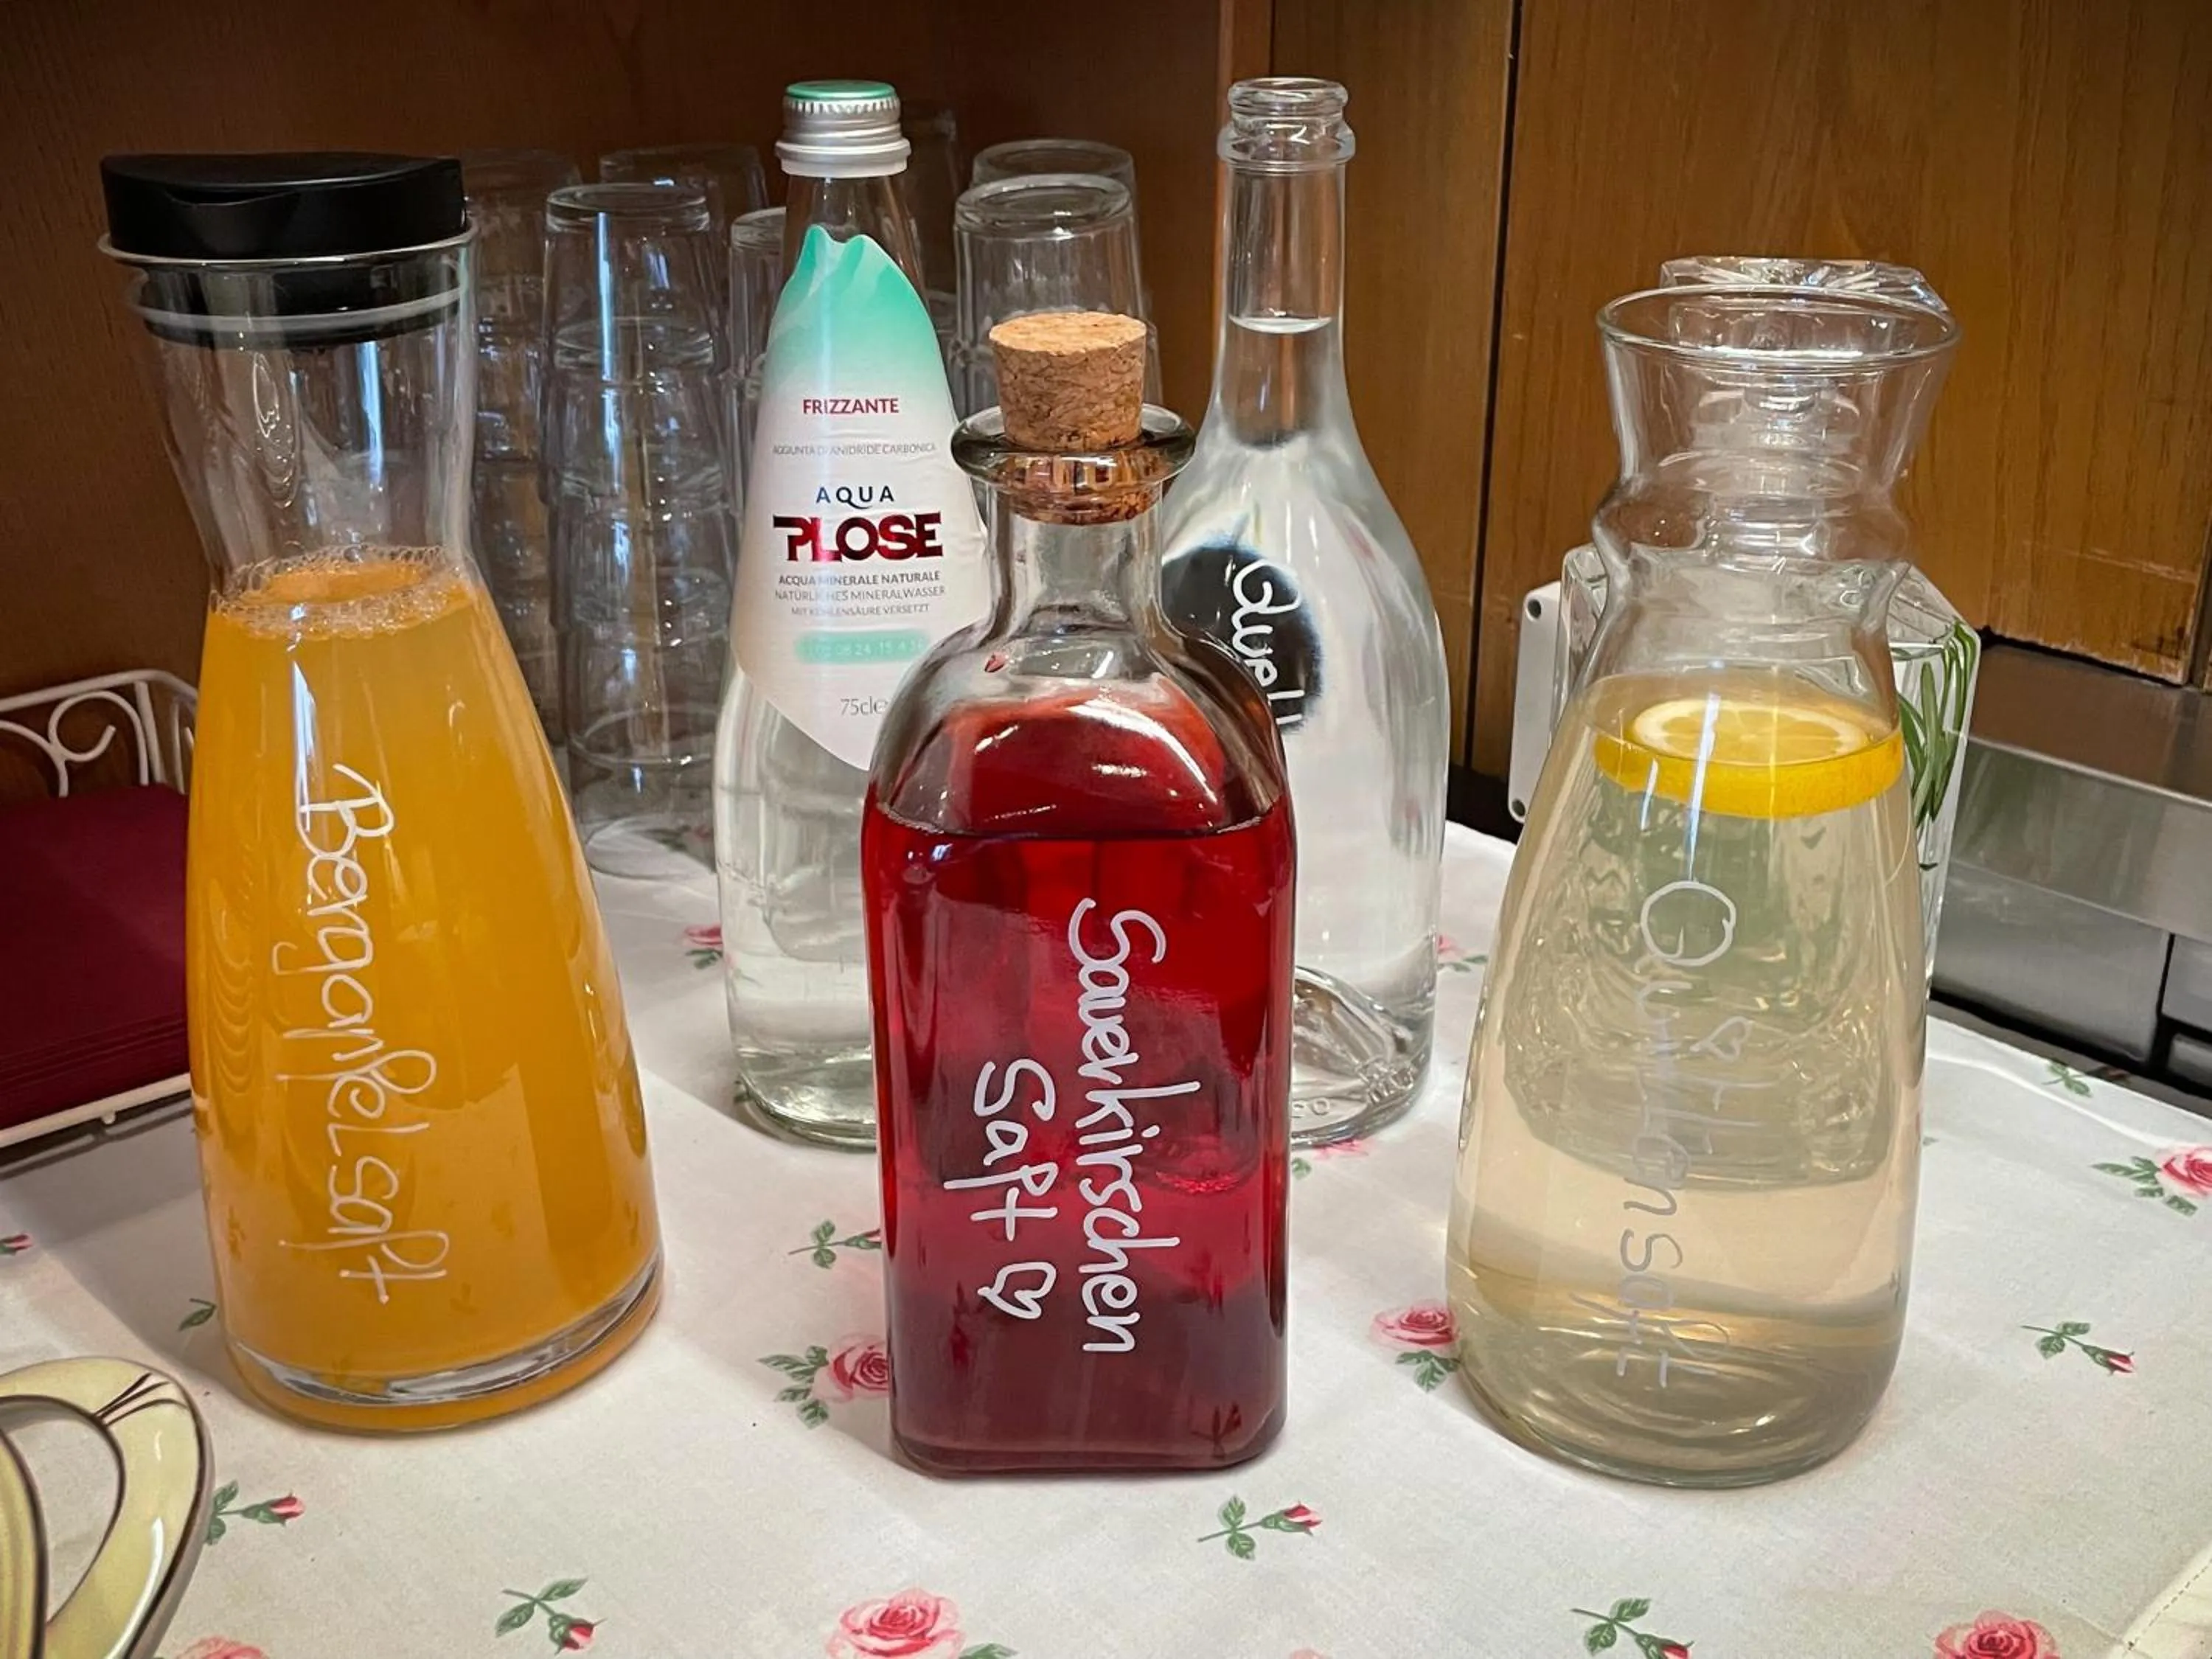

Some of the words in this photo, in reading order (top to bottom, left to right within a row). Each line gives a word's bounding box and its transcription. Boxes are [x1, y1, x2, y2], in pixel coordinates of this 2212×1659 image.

[802, 397, 900, 414] FRIZZANTE
[815, 484, 895, 510] AQUA
[772, 512, 944, 563] PLOSE
[778, 574, 816, 587] ACQUA
[881, 570, 942, 584] NATURALE
[850, 585, 945, 601] MINERALWASSER
[883, 602, 931, 615] VERSETZT
[272, 762, 451, 1305] Bergapfelsaft
[1068, 897, 1202, 1353] Sauerkirschen
[943, 1058, 1059, 1242] Saft
